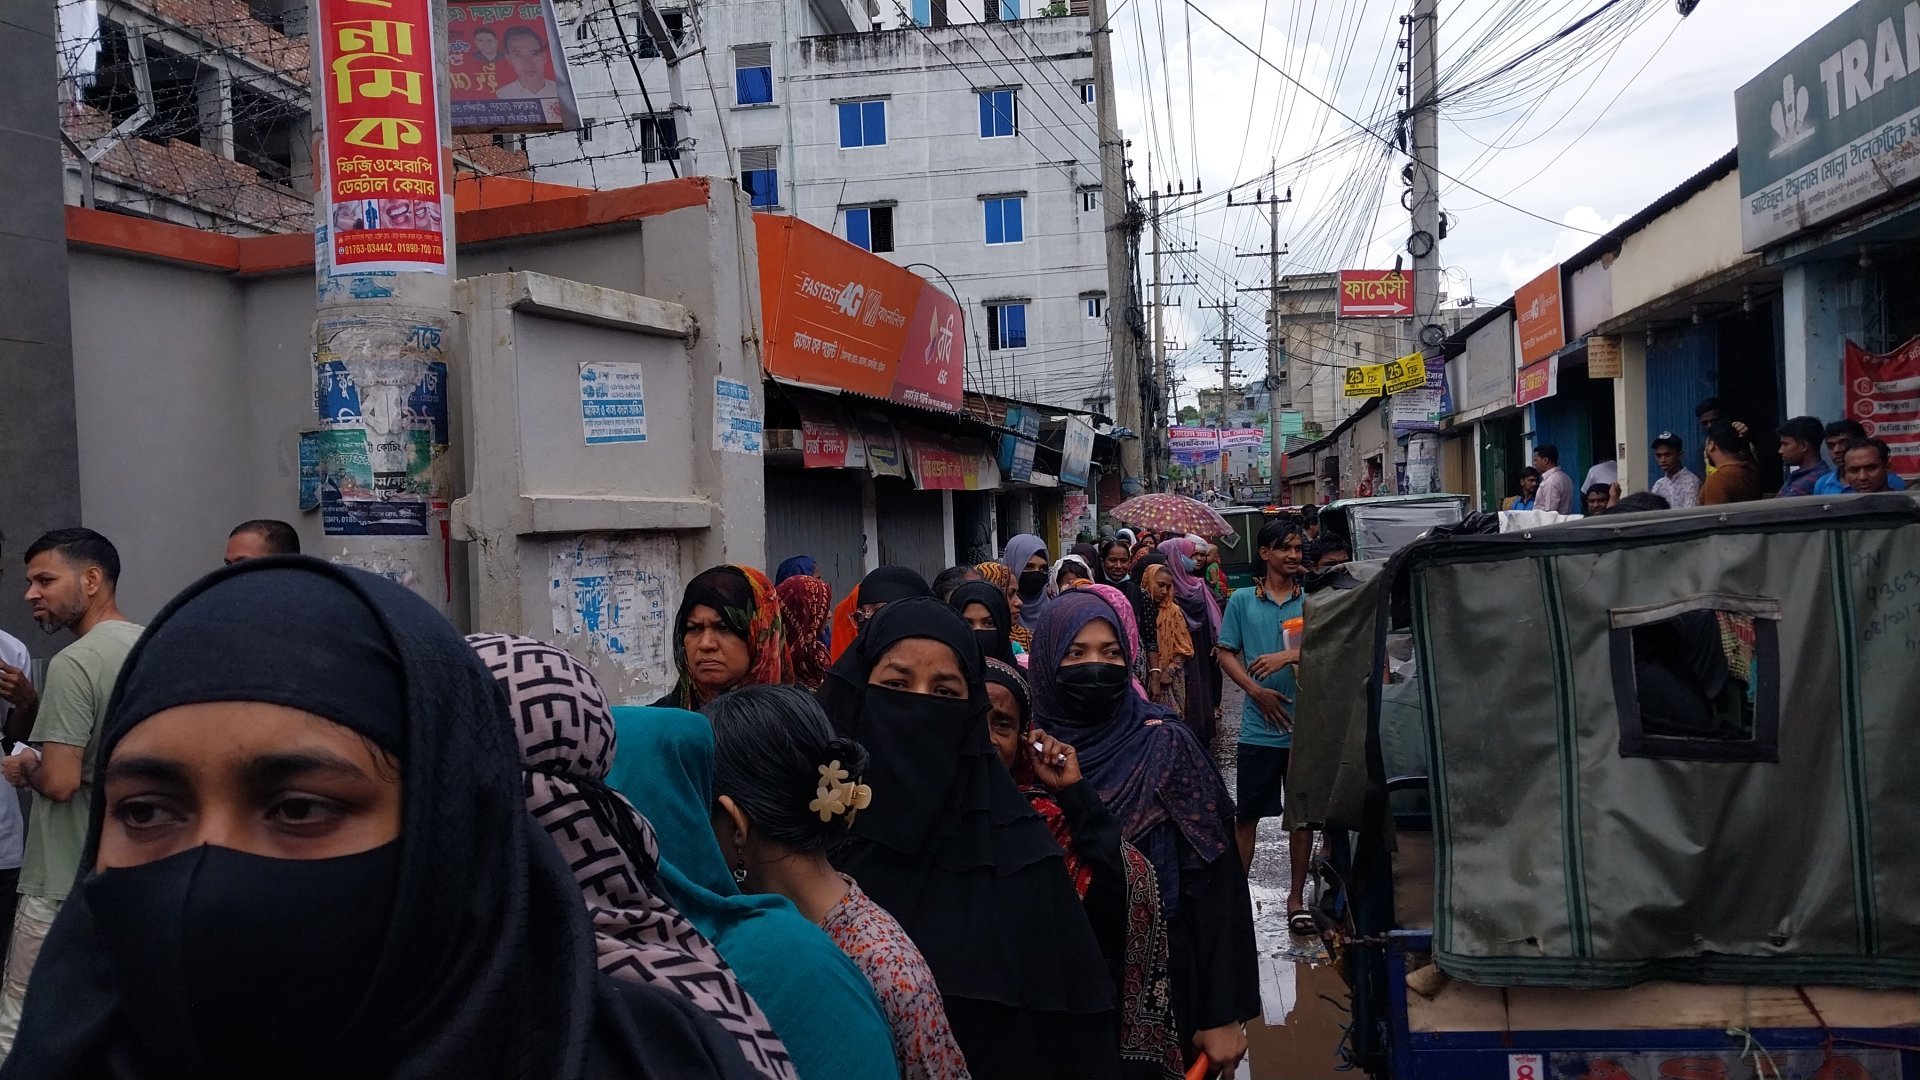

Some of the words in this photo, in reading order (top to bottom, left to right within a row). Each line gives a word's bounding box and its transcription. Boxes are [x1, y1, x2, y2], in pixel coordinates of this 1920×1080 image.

[337, 155, 433, 175] ফিজিওথেরাপি
[338, 174, 389, 195] ডেন্টাল
[393, 178, 435, 196] কেয়ার
[1342, 272, 1410, 300] ফার্মেসী
[801, 276, 841, 305] FASTEST
[837, 282, 864, 318] 4G
[1349, 370, 1361, 383] 25
[1388, 364, 1401, 379] 25
